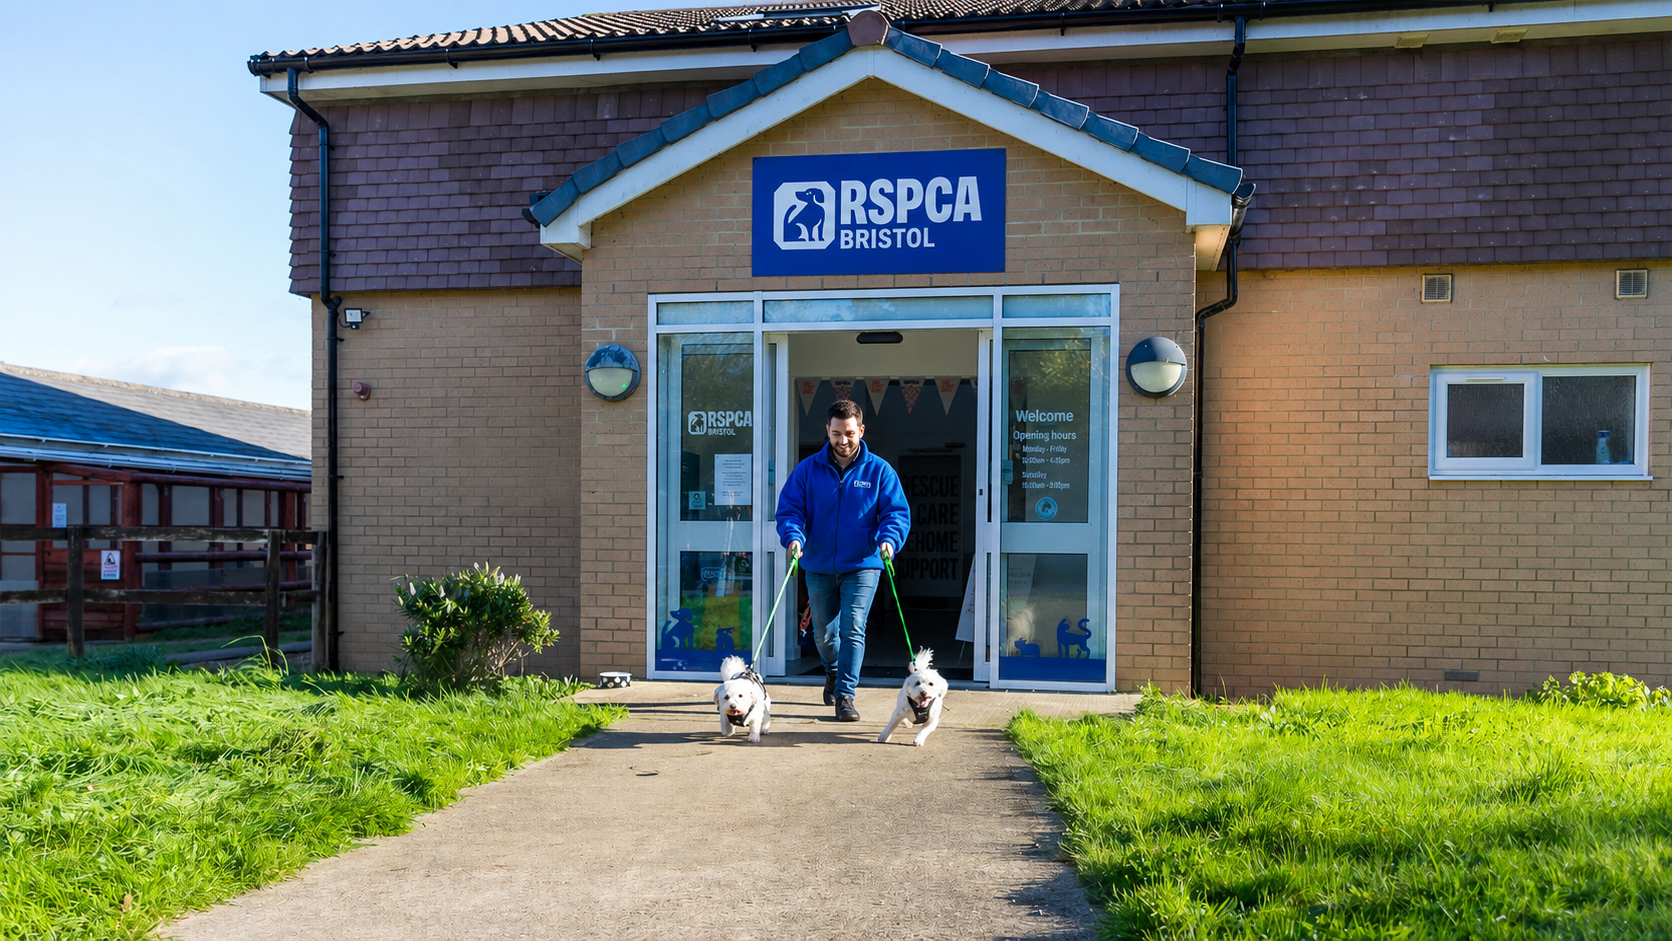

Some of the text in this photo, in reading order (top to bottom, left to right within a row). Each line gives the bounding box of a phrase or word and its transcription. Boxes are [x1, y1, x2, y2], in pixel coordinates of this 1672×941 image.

[840, 176, 982, 225] RSPCA
[840, 227, 935, 249] BRISTOL
[707, 410, 753, 427] RSPCA
[1015, 409, 1074, 422] Welcome
[707, 428, 736, 436] BRISTOL
[1012, 430, 1077, 442] Opening hours
[901, 475, 958, 497] RESCUE
[917, 503, 958, 525] CARE
[905, 531, 958, 553] EHOME
[899, 557, 958, 580] UPPORT
